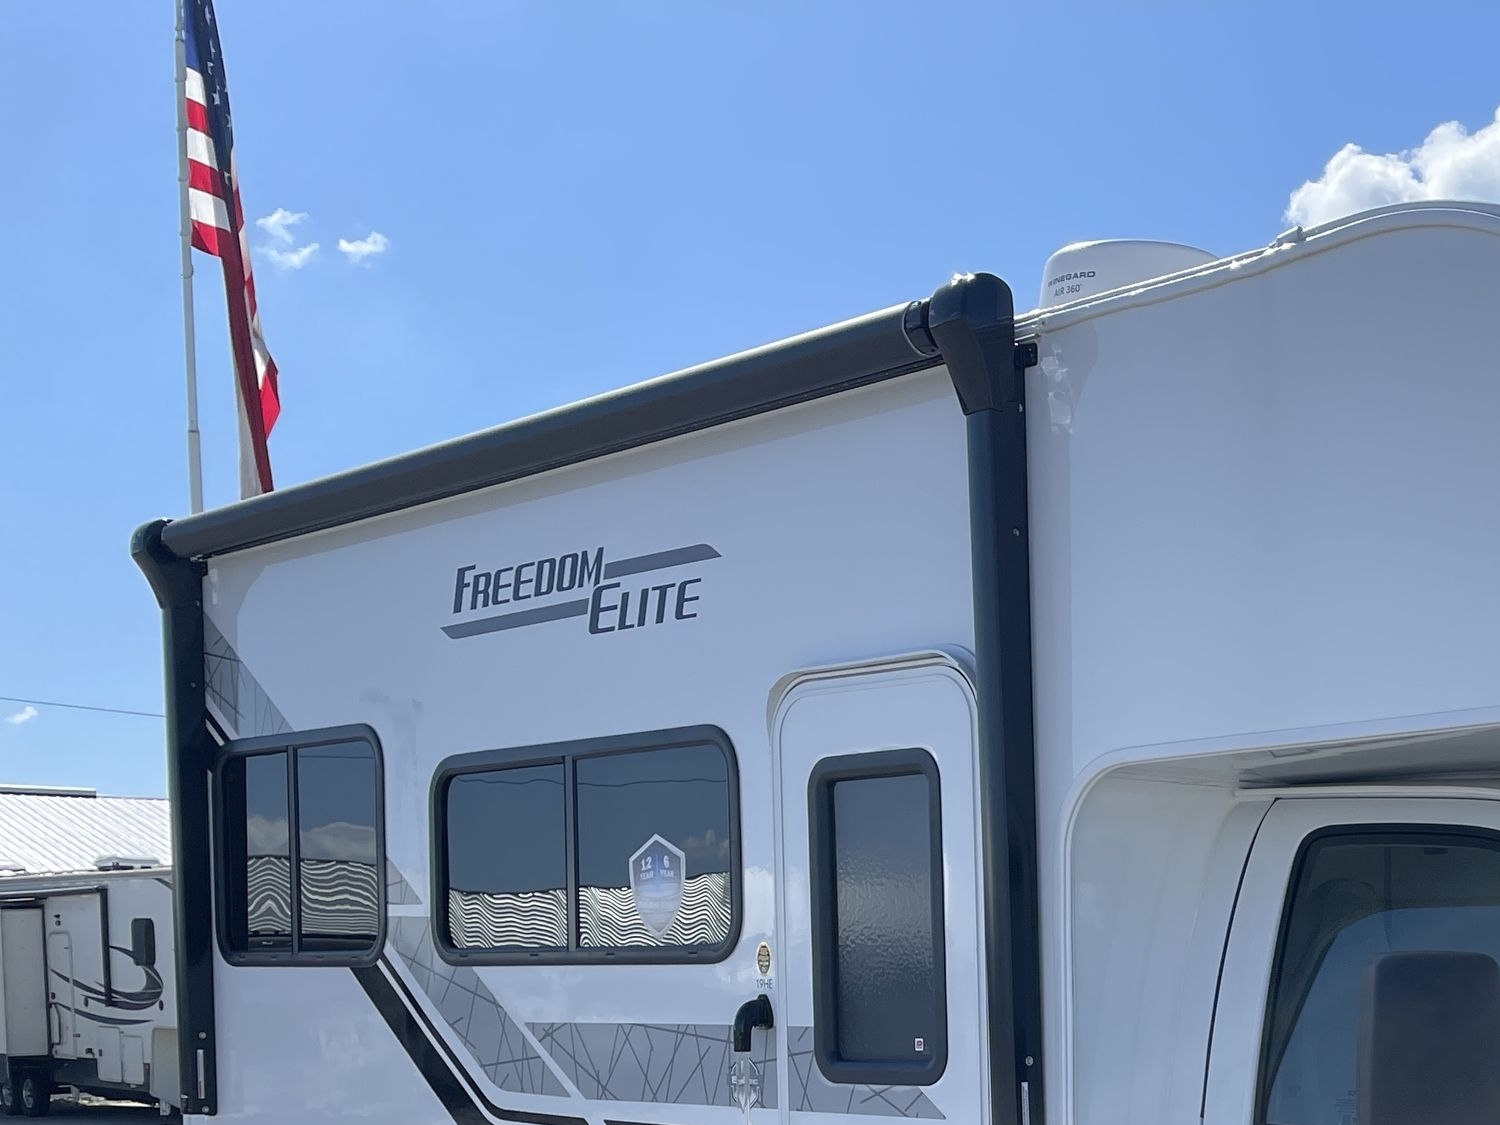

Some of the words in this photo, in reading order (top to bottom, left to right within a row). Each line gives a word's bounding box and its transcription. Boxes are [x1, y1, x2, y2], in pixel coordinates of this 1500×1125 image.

[452, 546, 605, 614] FREEDOM
[588, 577, 702, 635] ELITE
[641, 856, 652, 871] 12
[663, 855, 670, 868] 6
[756, 978, 773, 990] 19HE
